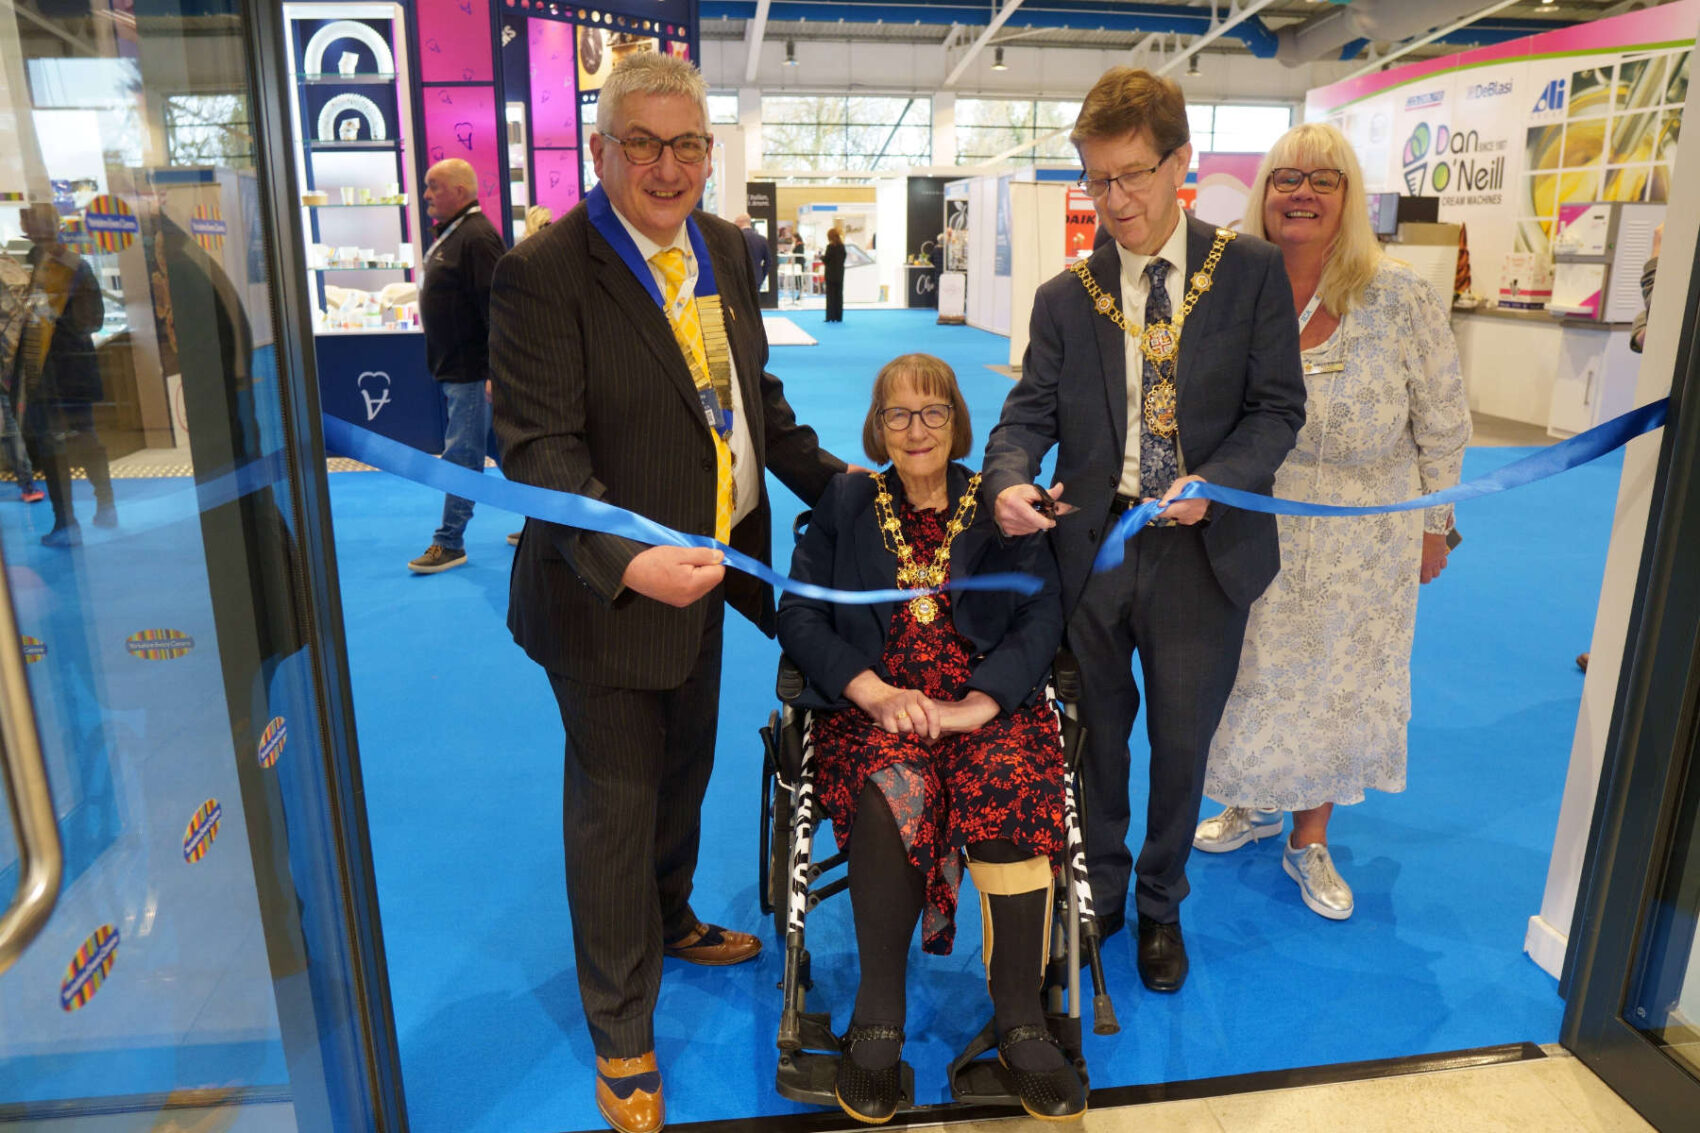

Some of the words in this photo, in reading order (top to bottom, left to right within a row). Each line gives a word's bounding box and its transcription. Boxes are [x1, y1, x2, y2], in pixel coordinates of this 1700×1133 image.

[1532, 79, 1566, 113] Ali
[1435, 125, 1479, 155] Dan
[1432, 156, 1505, 192] O'Neill
[1467, 194, 1502, 205] MACHINES
